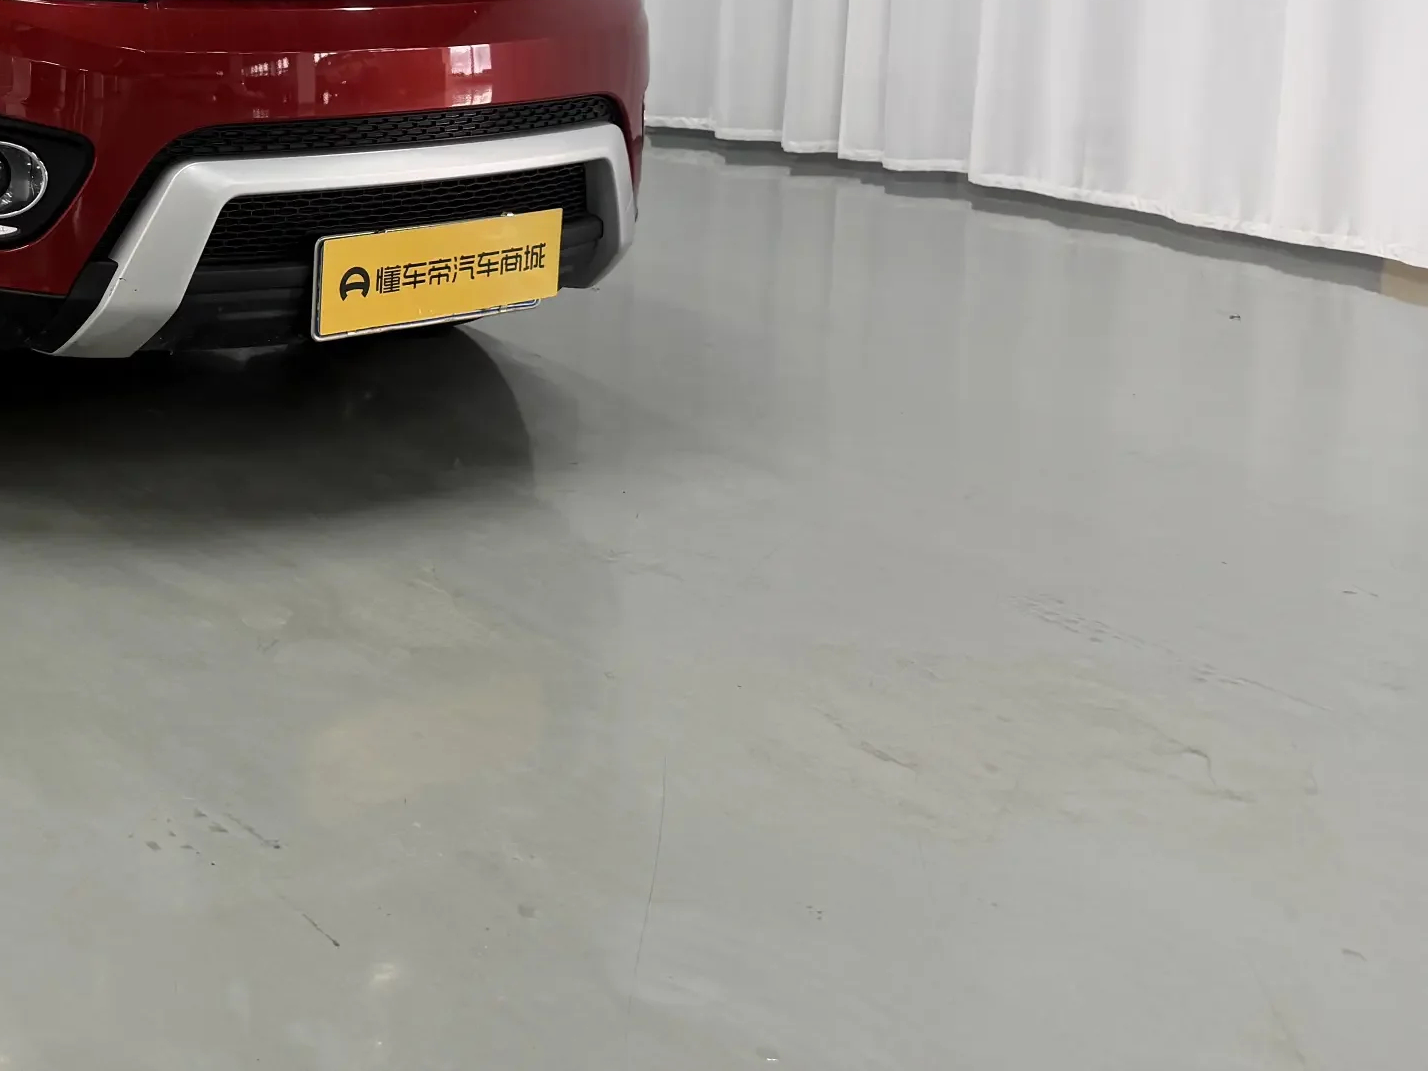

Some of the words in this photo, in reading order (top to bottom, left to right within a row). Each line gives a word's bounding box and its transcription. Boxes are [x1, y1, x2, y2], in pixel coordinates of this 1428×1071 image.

[375, 242, 547, 294] 懂车帝汽车商城
